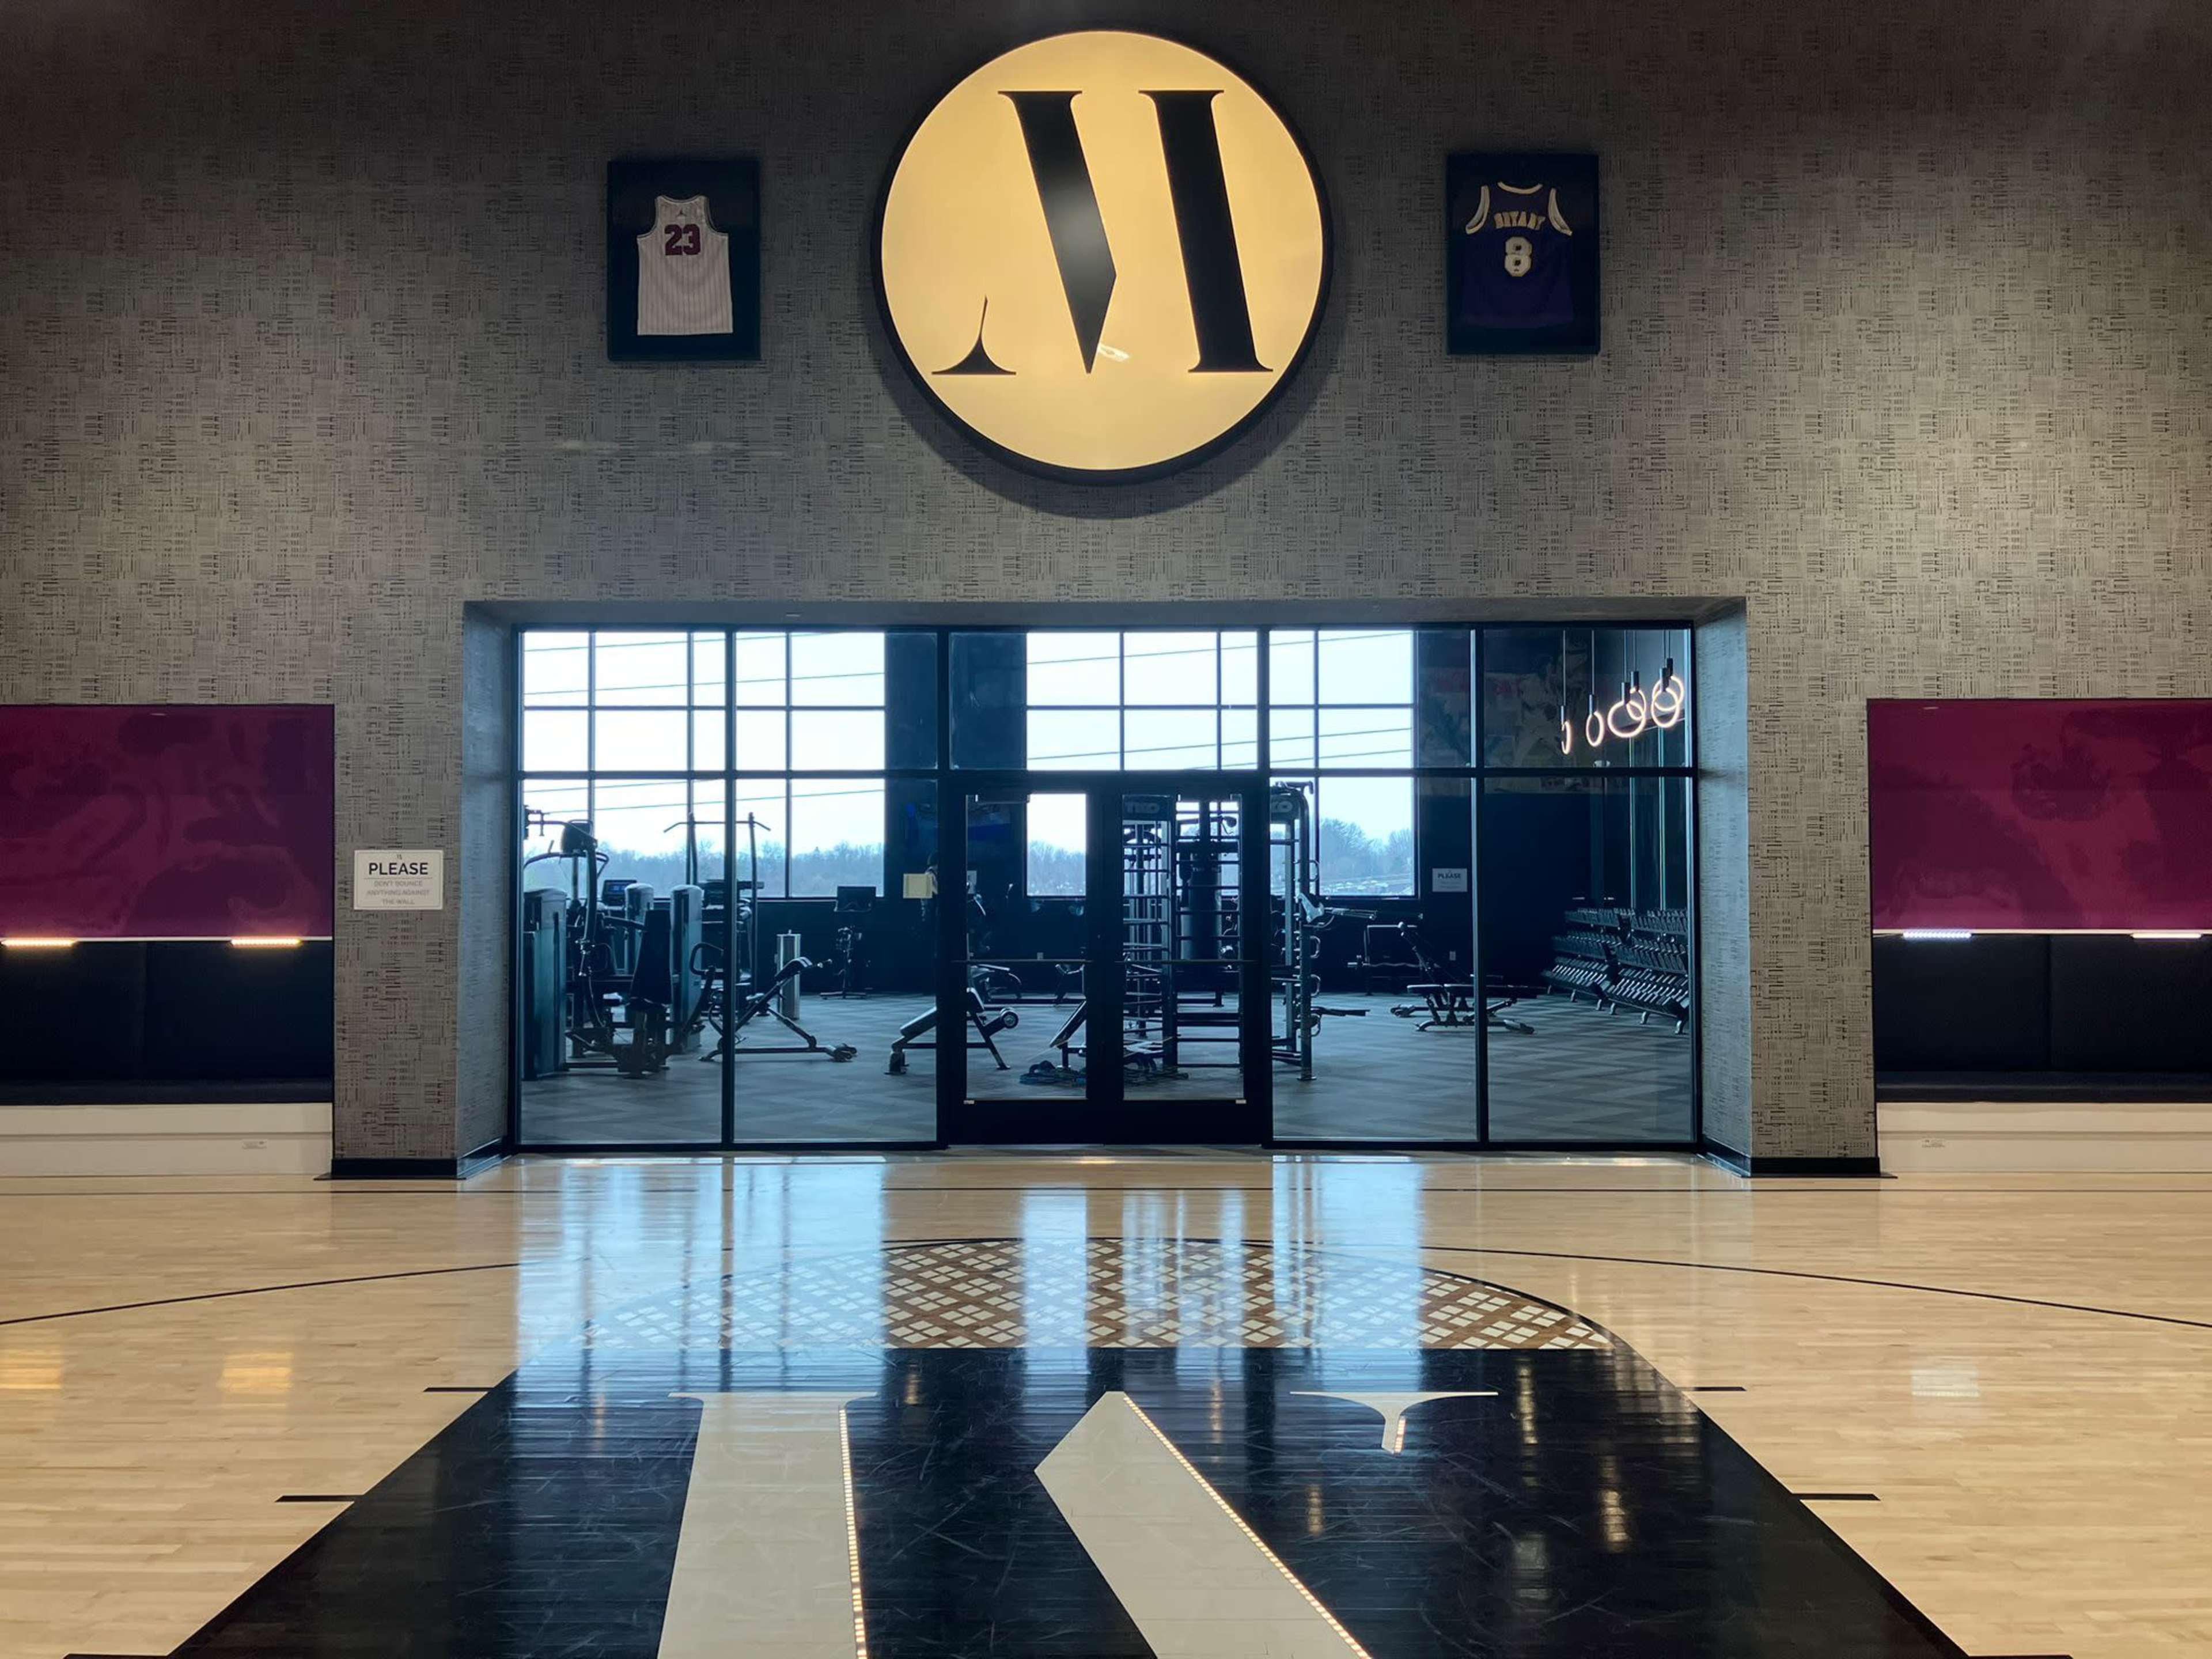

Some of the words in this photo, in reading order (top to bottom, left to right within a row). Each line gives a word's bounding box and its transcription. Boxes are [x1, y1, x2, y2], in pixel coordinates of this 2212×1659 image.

[931, 90, 1274, 376] M
[1494, 210, 1546, 230] BRYANT
[665, 224, 701, 256] 23
[1504, 236, 1532, 276] 8
[369, 863, 429, 875] PLEASE
